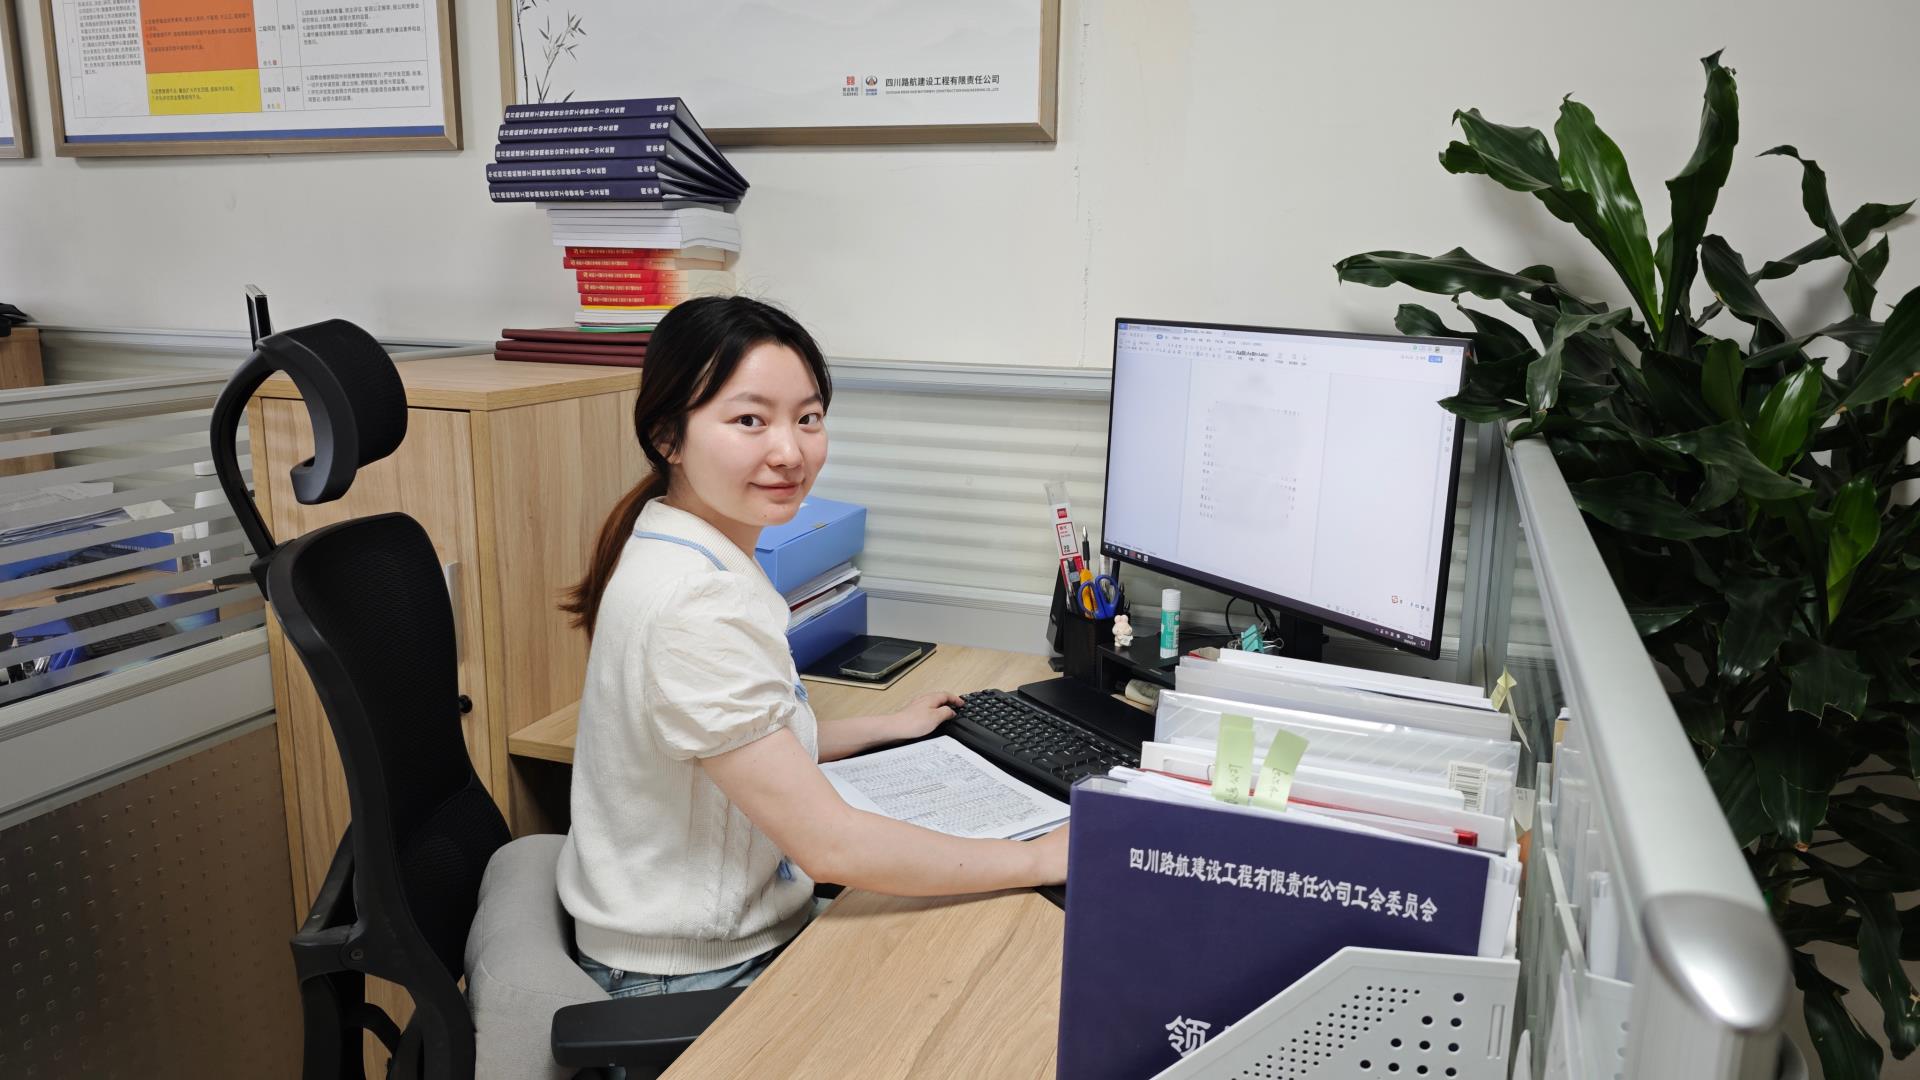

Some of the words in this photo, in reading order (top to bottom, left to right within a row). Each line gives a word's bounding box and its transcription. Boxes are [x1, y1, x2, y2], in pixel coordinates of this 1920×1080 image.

[885, 74, 1000, 87] 四川路航建设工程有限责任公司
[1129, 847, 1438, 922] 四川路航建设工程有限责任公司工会委员会
[1165, 1015, 1231, 1058] 领
